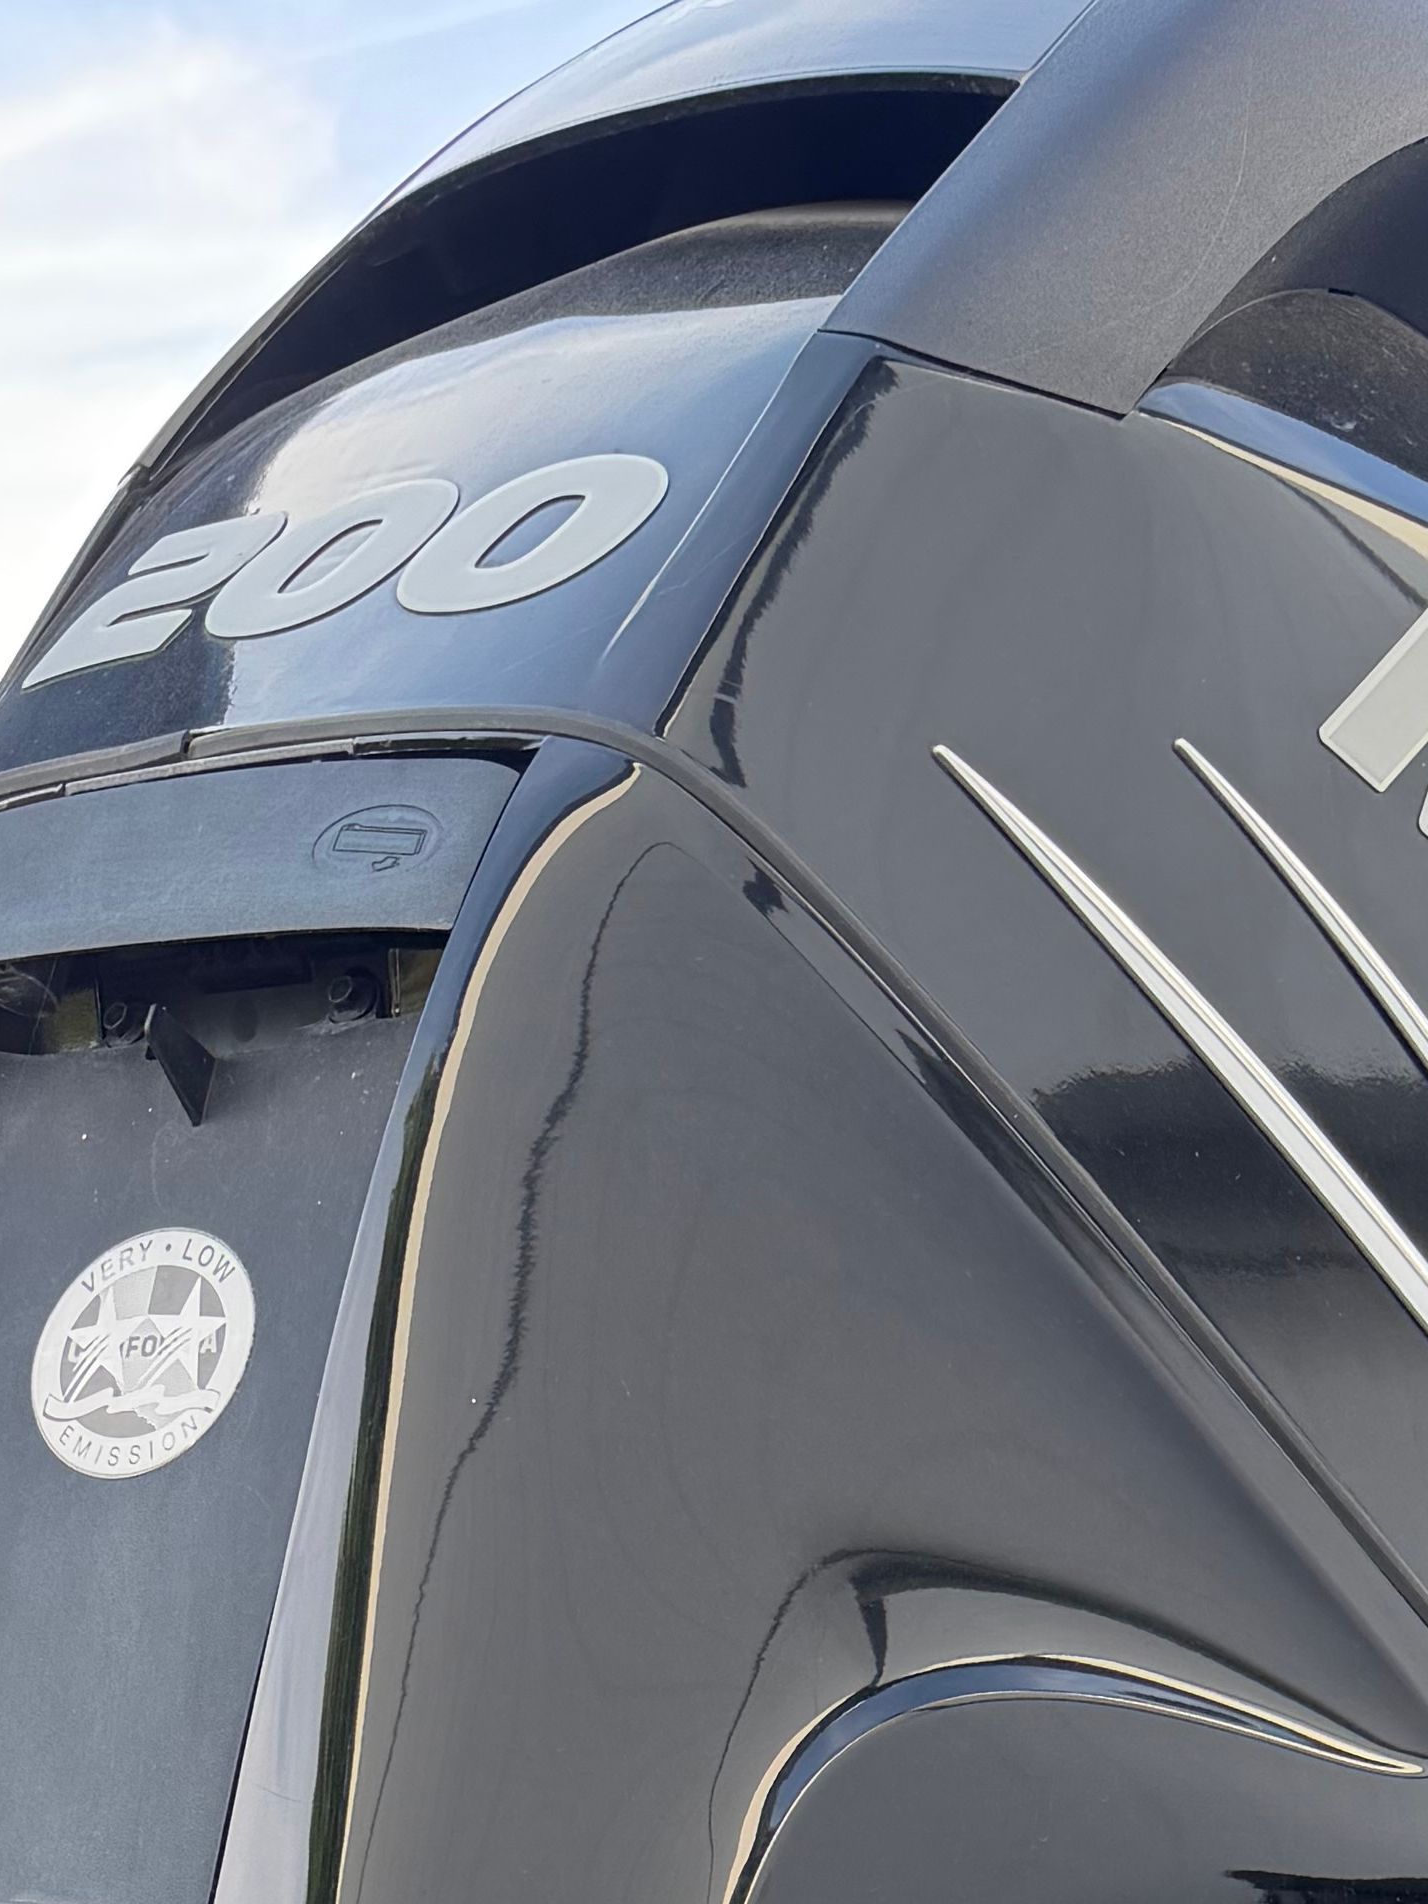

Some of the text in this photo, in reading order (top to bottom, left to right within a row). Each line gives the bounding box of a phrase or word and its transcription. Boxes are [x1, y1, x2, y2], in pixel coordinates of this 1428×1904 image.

[21, 452, 670, 691] 200
[80, 1237, 237, 1294] VERY LOW
[58, 1414, 199, 1467] EMISSION
